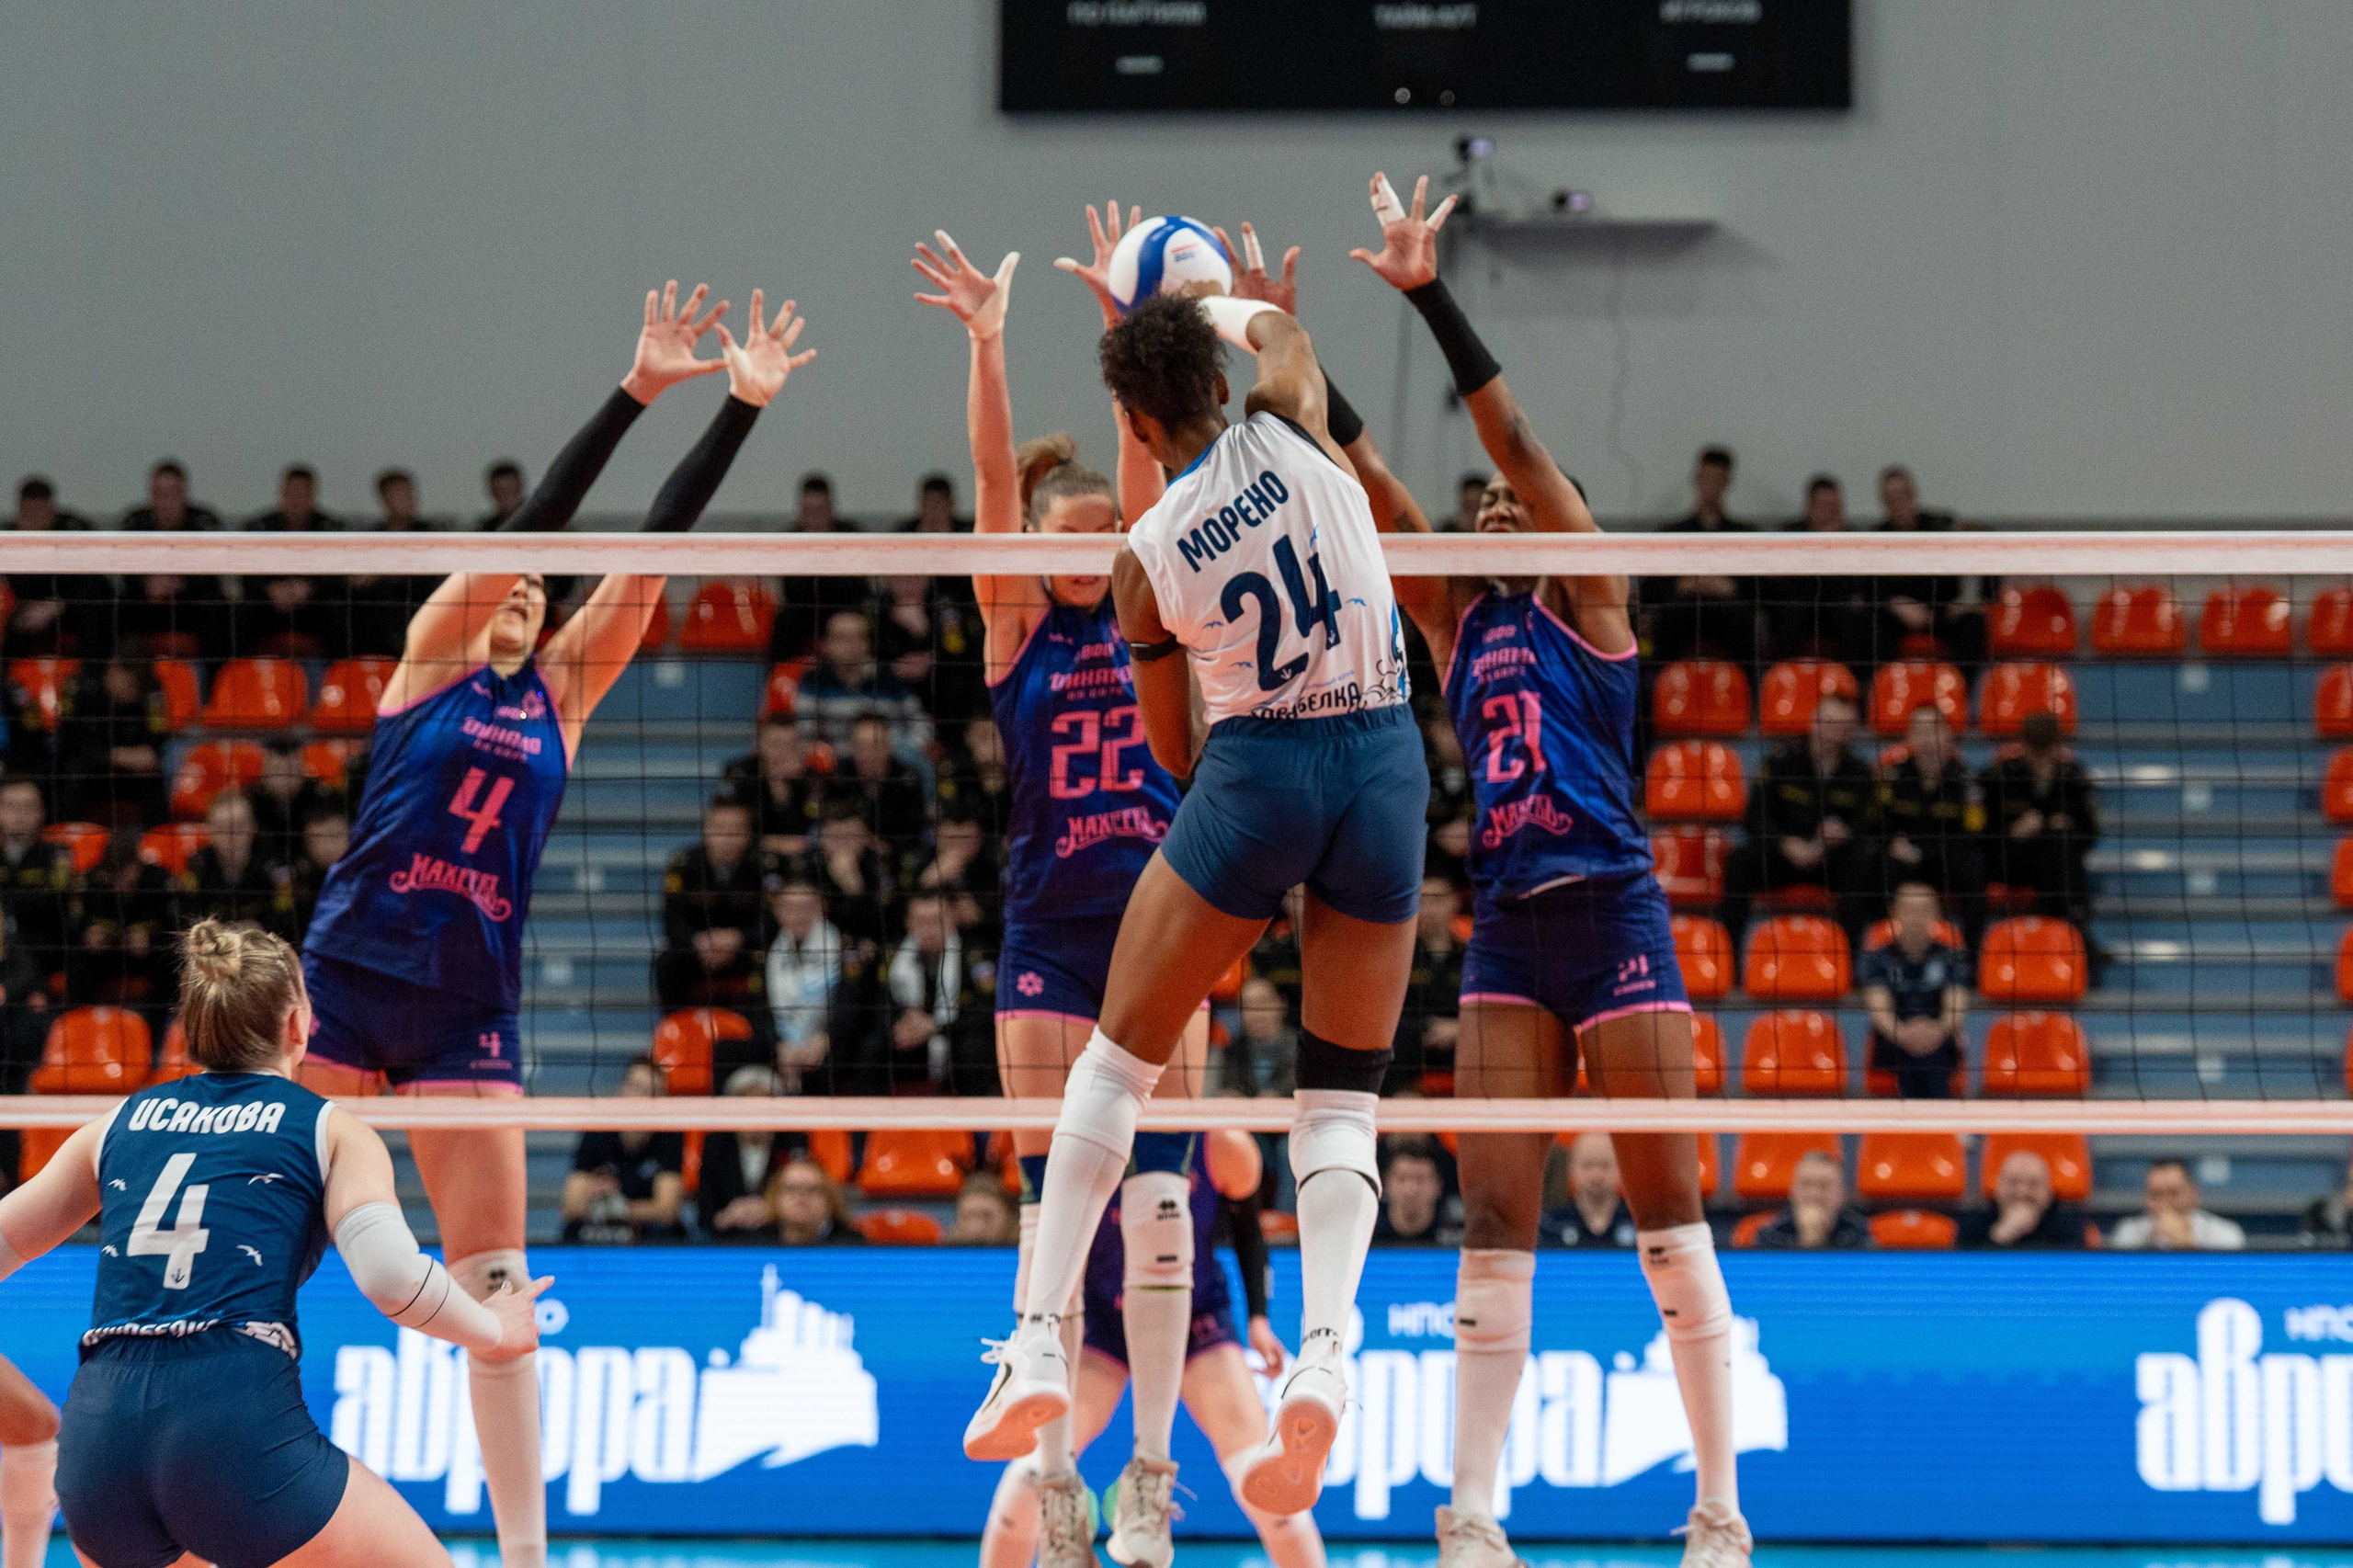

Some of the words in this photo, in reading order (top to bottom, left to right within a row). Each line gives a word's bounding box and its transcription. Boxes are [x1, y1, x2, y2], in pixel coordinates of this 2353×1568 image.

[1176, 470, 1289, 573] МОРЕНО
[1220, 533, 1342, 692] 24
[1050, 704, 1147, 800] 22
[1482, 689, 1547, 784] 21
[448, 766, 515, 855] 4
[479, 1031, 501, 1058] 4
[128, 1096, 286, 1134] ИСАКОВА
[126, 1152, 210, 1290] 4
